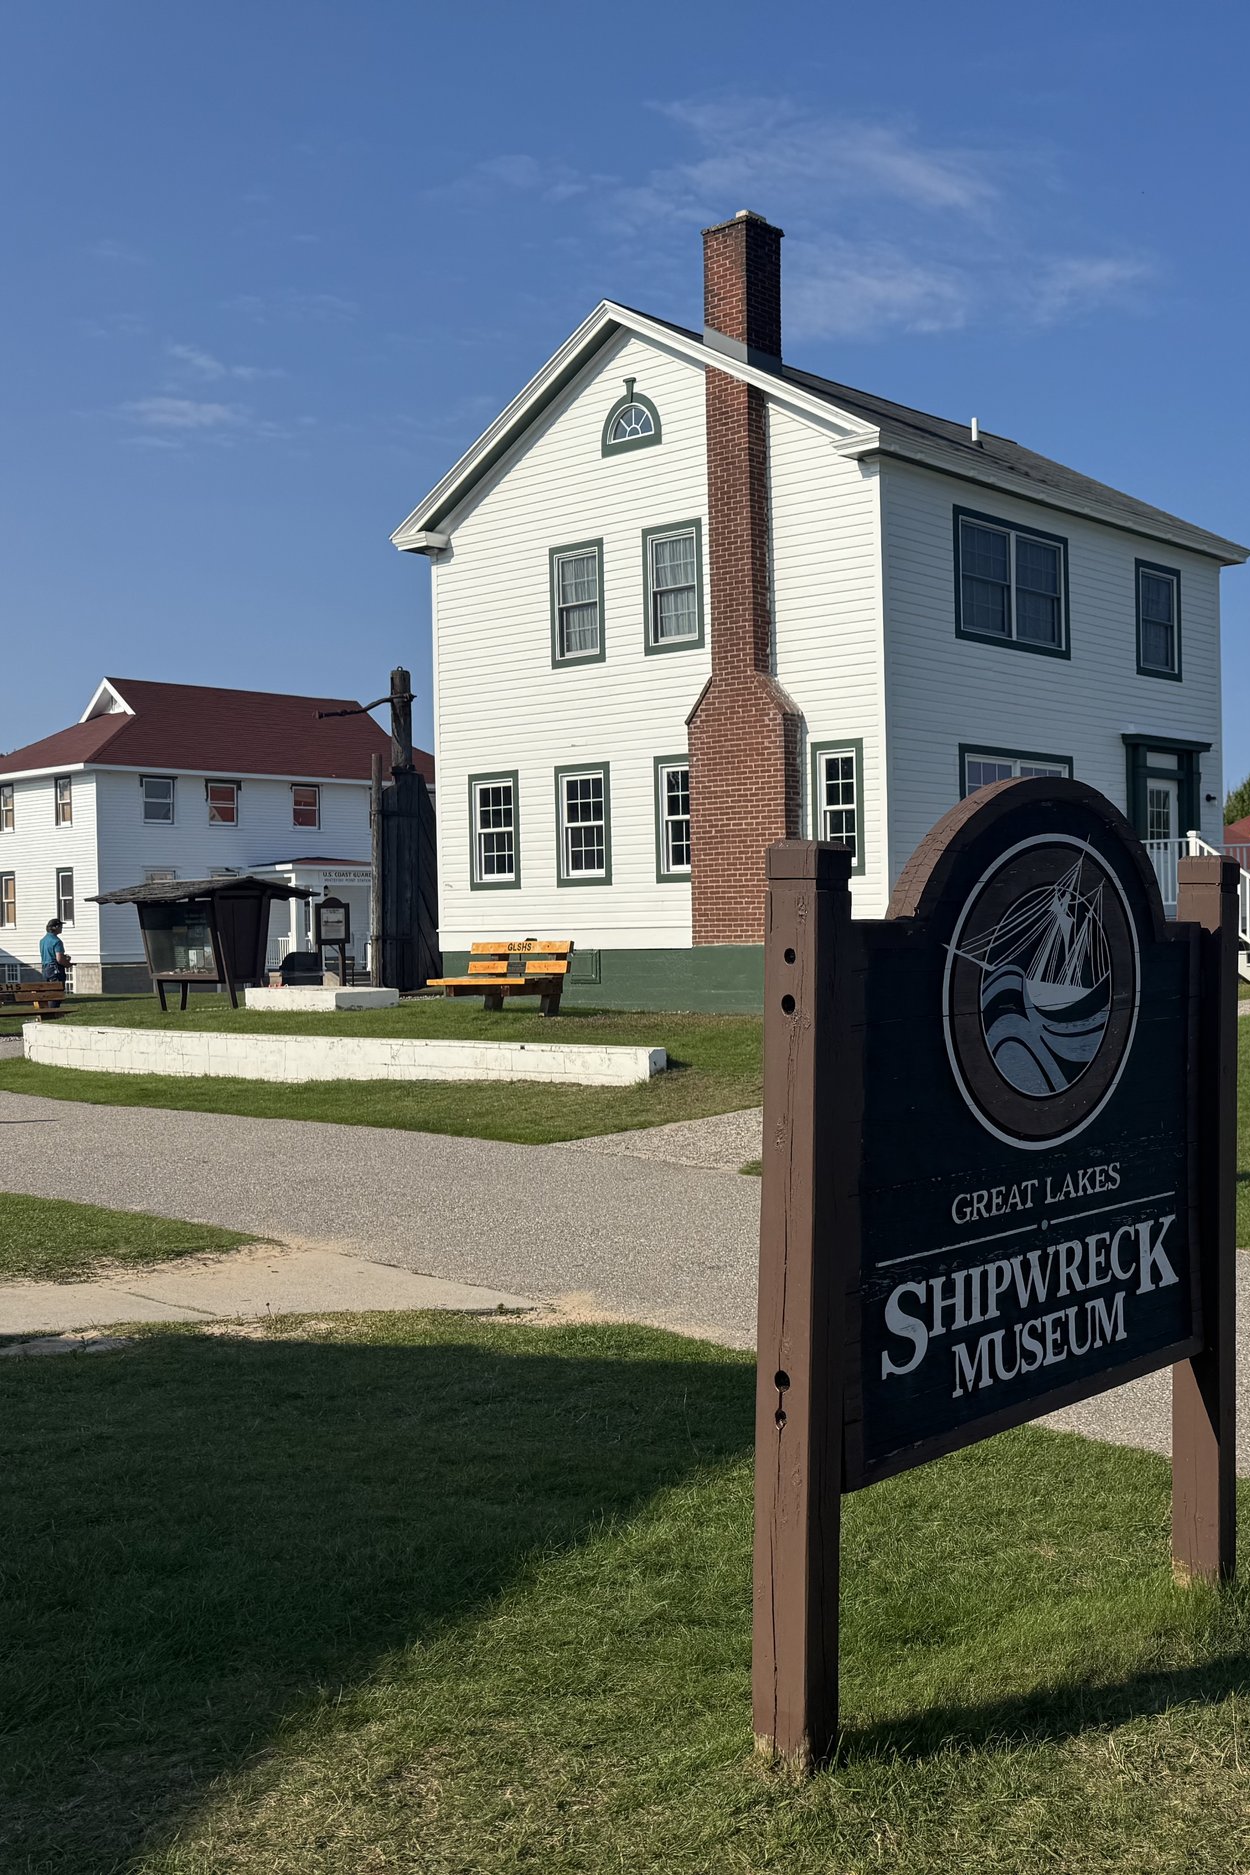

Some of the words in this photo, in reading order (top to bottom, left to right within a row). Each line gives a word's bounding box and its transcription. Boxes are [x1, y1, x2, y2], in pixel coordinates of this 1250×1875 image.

[507, 942, 532, 951] GLSHS
[951, 1179, 1039, 1225] GREAT
[1044, 1162, 1121, 1204] LAKES
[881, 1214, 1180, 1381] SHIPWRECK
[951, 1291, 1128, 1399] MUSEUM
